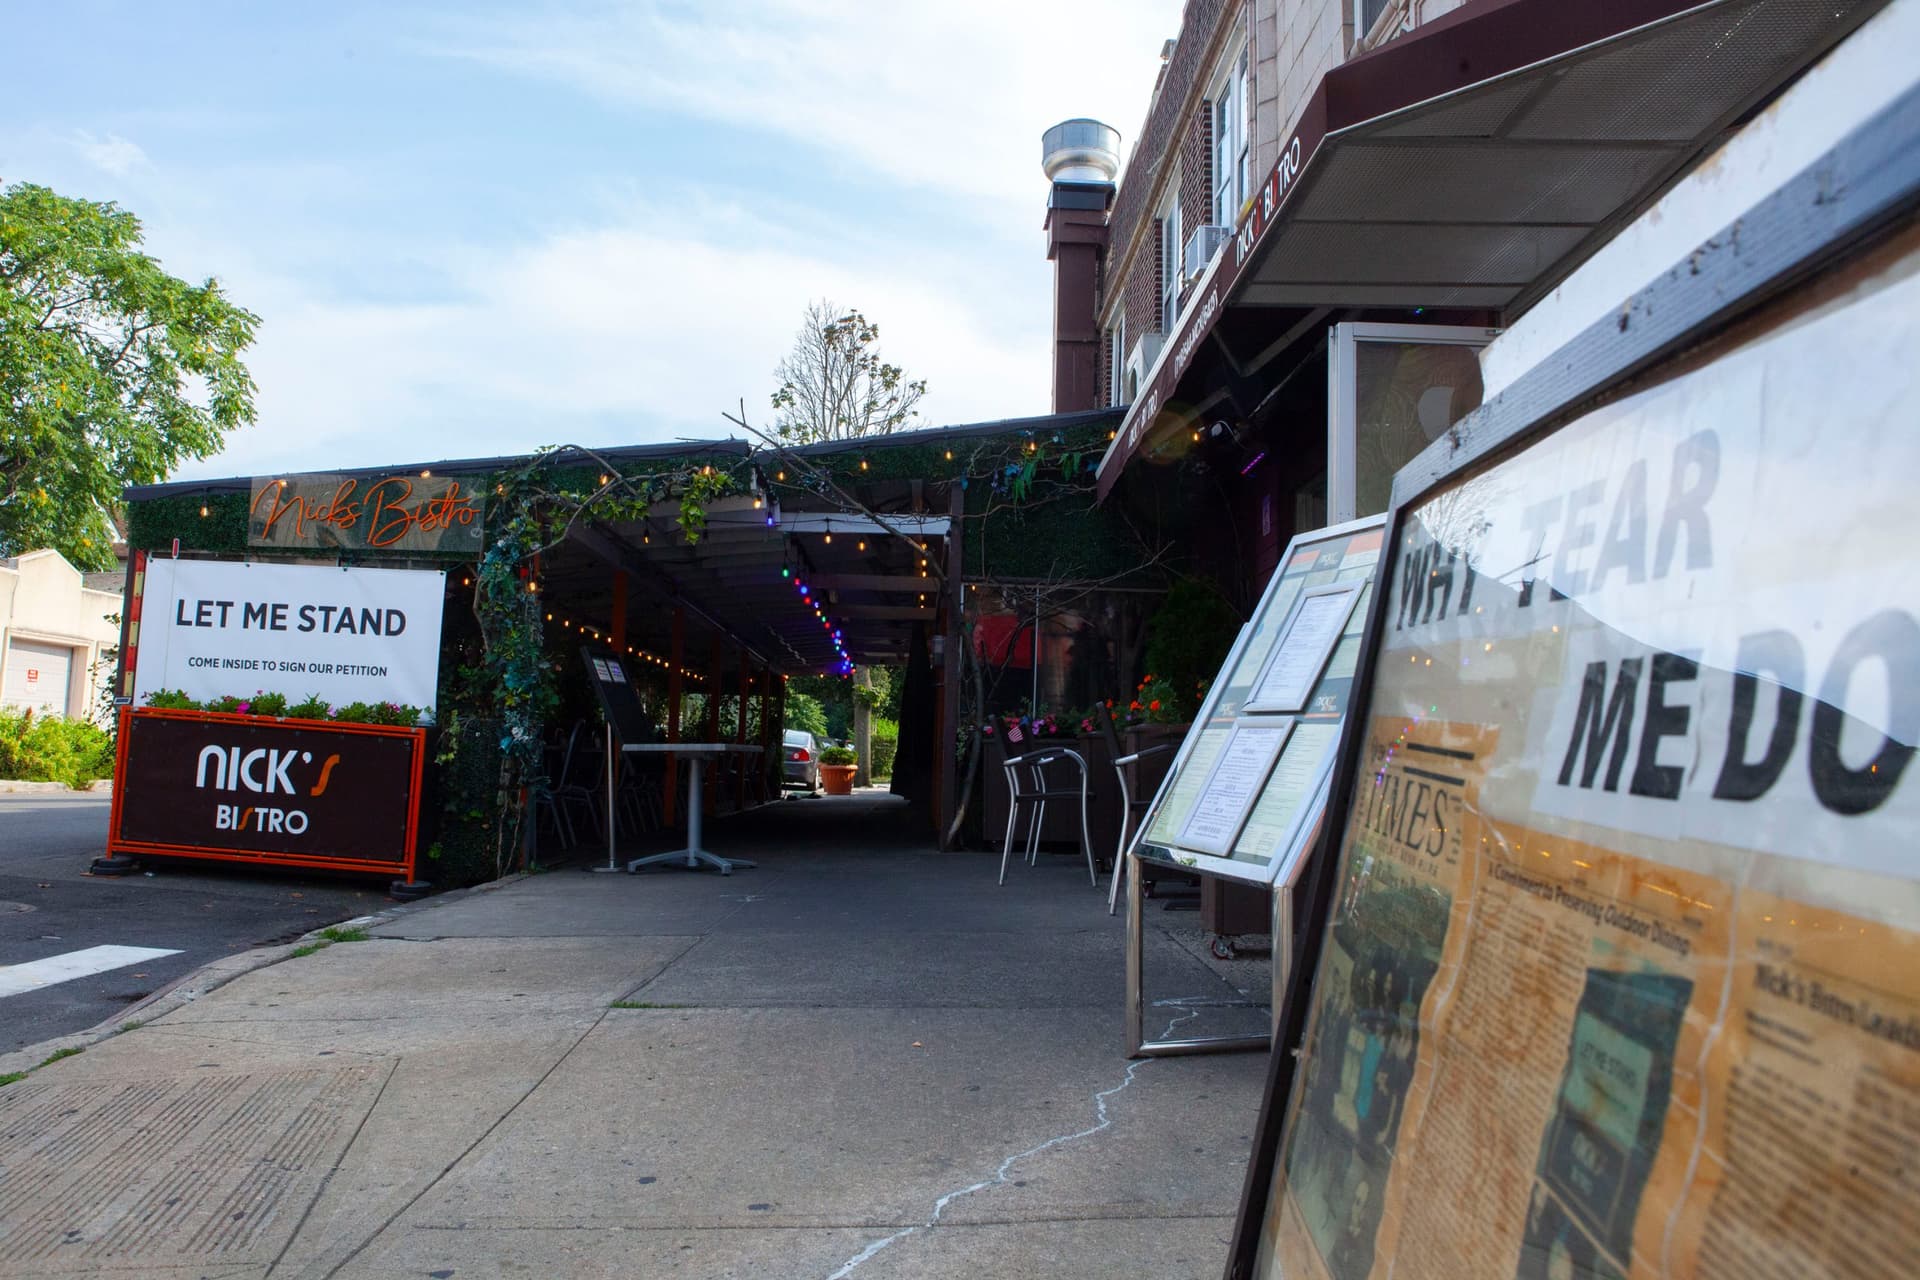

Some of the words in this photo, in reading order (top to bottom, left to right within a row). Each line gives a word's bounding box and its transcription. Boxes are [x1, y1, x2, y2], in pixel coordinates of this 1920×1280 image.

[1236, 198, 1262, 267] NICK'S
[1264, 136, 1300, 221] BISTRO
[250, 479, 362, 540] Nicks
[364, 477, 481, 546] Bistro
[1516, 427, 1722, 609] TEAR
[176, 599, 234, 629] LET
[243, 601, 289, 631] ME
[297, 604, 407, 637] STAND
[188, 656, 220, 669] COME
[222, 658, 259, 671] INSIDE
[262, 660, 277, 672] TO
[279, 661, 306, 673] SIGN
[308, 663, 333, 675] OUR
[336, 665, 387, 677] PETITION
[1557, 647, 1704, 802] ME
[1711, 608, 1920, 818] DO
[196, 744, 340, 797] NICK'S
[216, 804, 309, 835] BISTRO
[1365, 772, 1449, 857] TIMES
